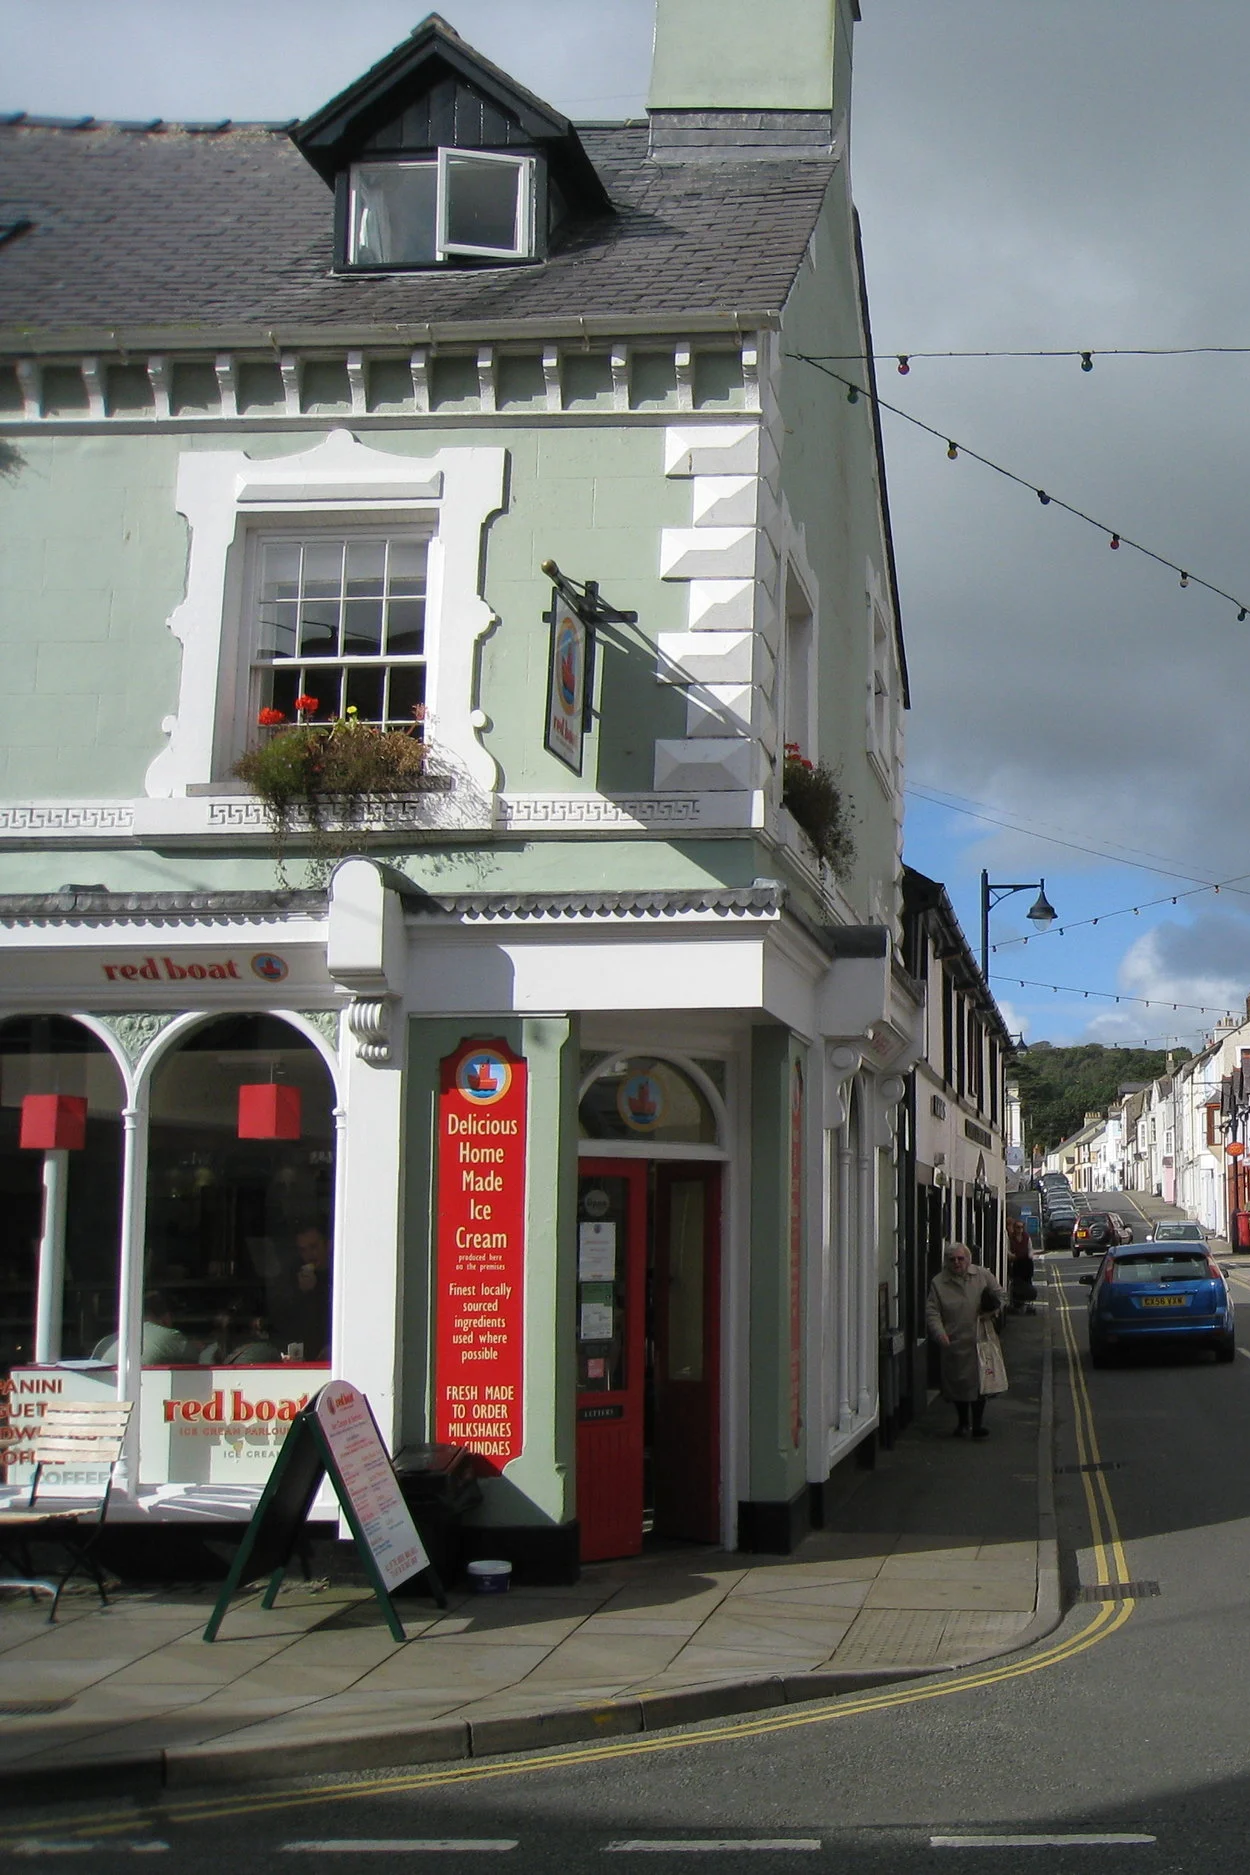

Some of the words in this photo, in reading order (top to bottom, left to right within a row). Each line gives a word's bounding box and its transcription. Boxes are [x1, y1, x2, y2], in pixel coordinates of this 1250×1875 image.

[102, 954, 161, 981] red
[162, 956, 243, 980] boat
[448, 1113, 518, 1135] Delicious
[459, 1142, 504, 1163] Home
[462, 1170, 503, 1192] Made
[470, 1199, 491, 1220] Ice
[456, 1227, 507, 1249] Cream
[458, 1253, 486, 1262] produced
[489, 1253, 502, 1261] here
[466, 1262, 476, 1271] the
[480, 1262, 505, 1272] premises
[449, 1283, 476, 1296] Finest
[481, 1282, 512, 1299] locally
[463, 1299, 498, 1312] sourced
[454, 1315, 506, 1332] ingredients
[453, 1331, 473, 1344] used
[479, 1331, 507, 1344] where
[461, 1347, 498, 1364] possible
[446, 1385, 478, 1400] FRESH
[485, 1385, 514, 1400] MADE
[163, 1389, 225, 1422] red
[452, 1404, 466, 1418] TO
[472, 1404, 508, 1418] ORDER
[180, 1427, 197, 1436] ICE
[203, 1427, 241, 1436] CREAM
[448, 1422, 512, 1438] MILKSHAKES
